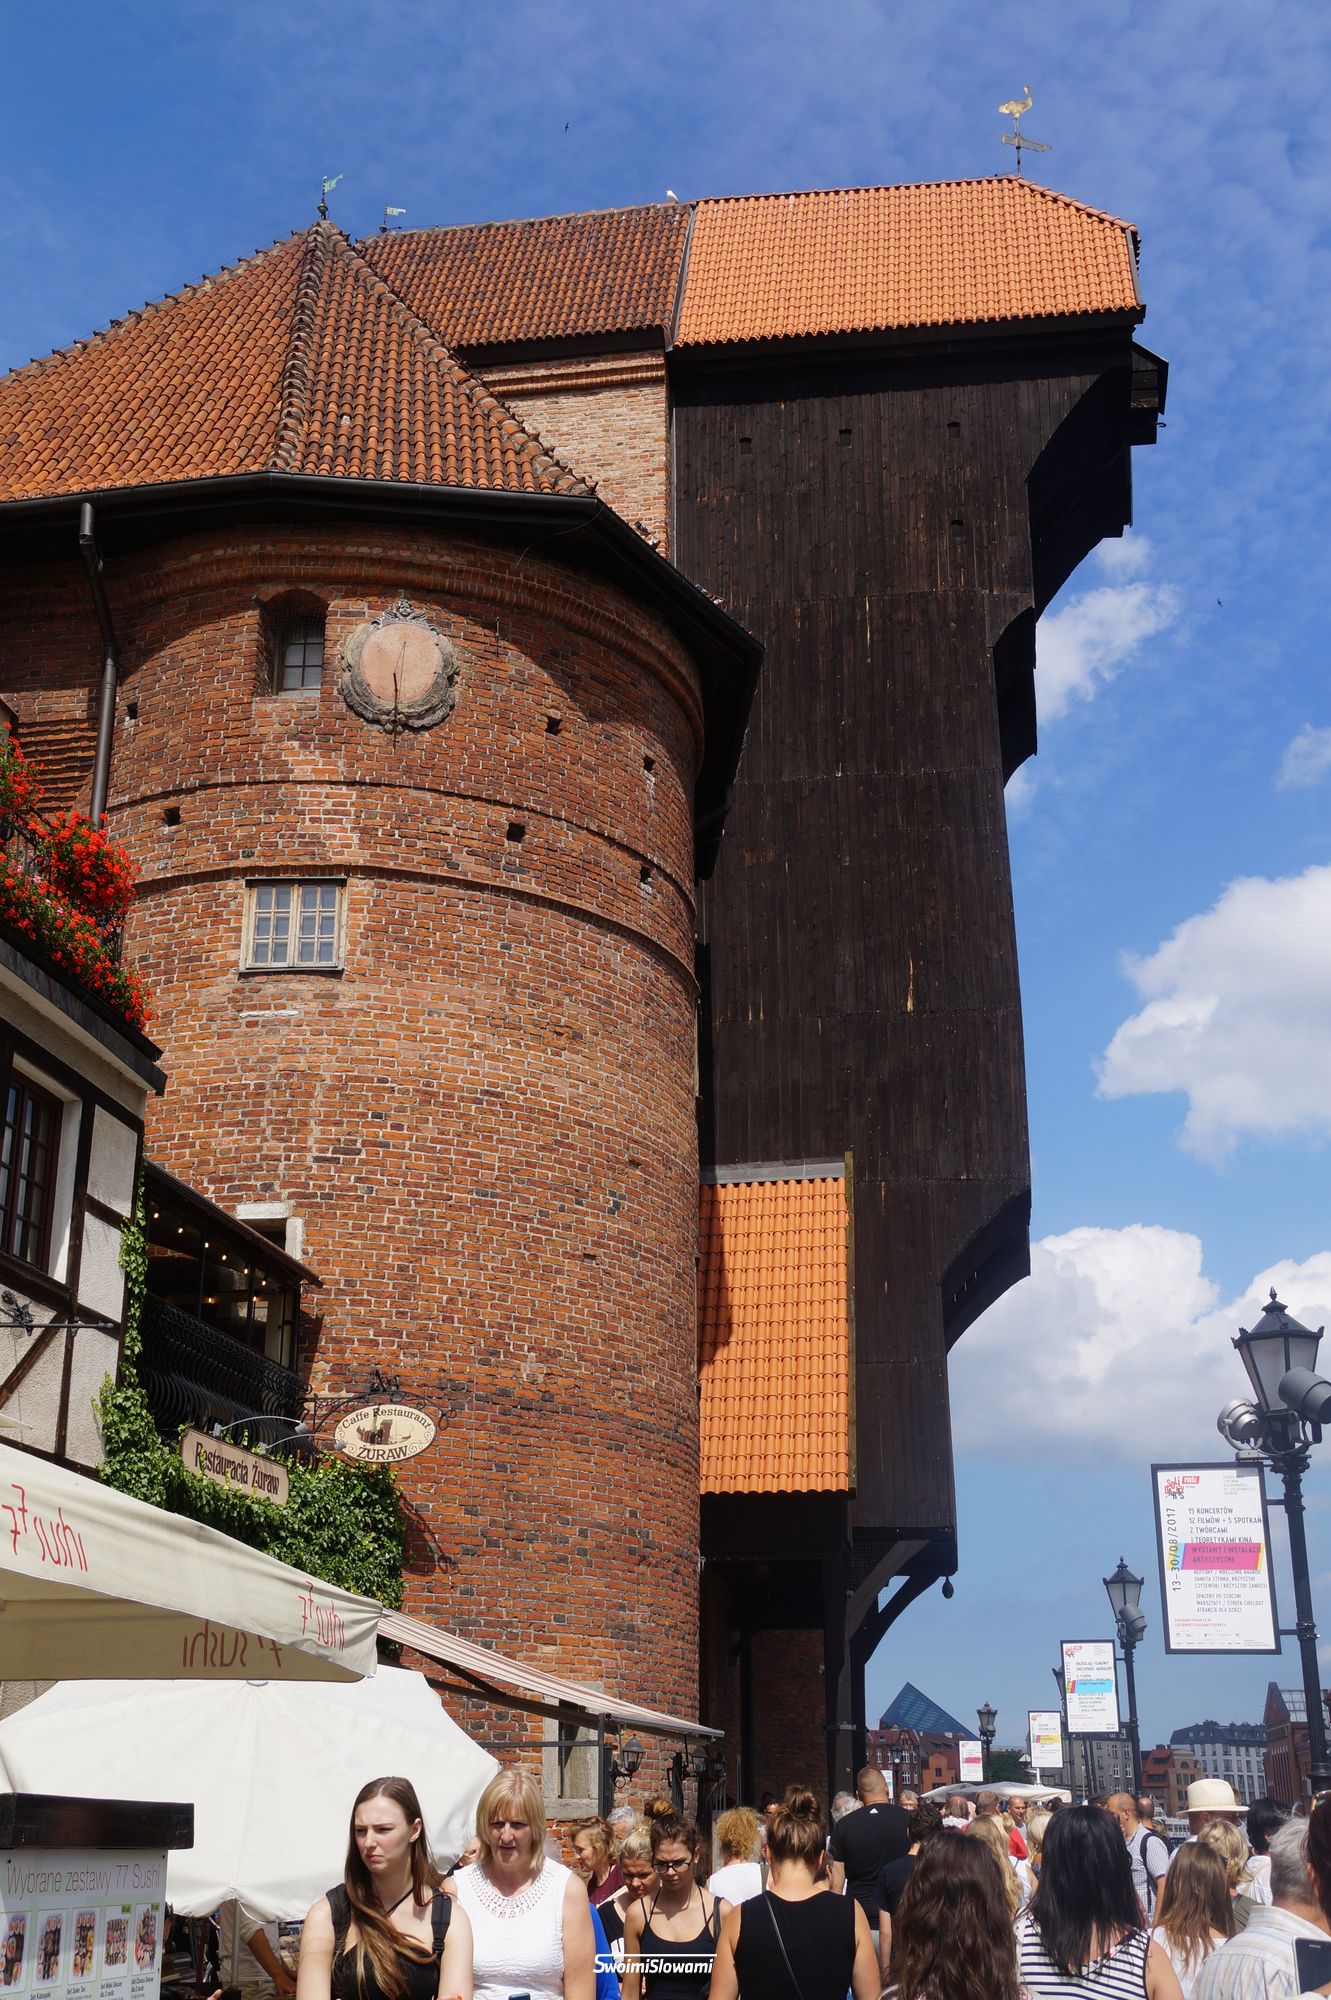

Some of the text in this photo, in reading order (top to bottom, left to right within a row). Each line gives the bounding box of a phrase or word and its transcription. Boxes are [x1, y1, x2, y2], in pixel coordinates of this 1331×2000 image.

[342, 1407, 432, 1429] Caffe Restaurant
[357, 1444, 408, 1460] ŻURAW
[252, 1461, 280, 1495] Żuraw
[2, 1484, 88, 1572] 77 sushi
[1195, 1525, 1228, 1533] TWÓRCAMI
[298, 1581, 344, 1652] 77 sushi
[8, 1864, 160, 1900] Wybrane zestawy 77 Sushi
